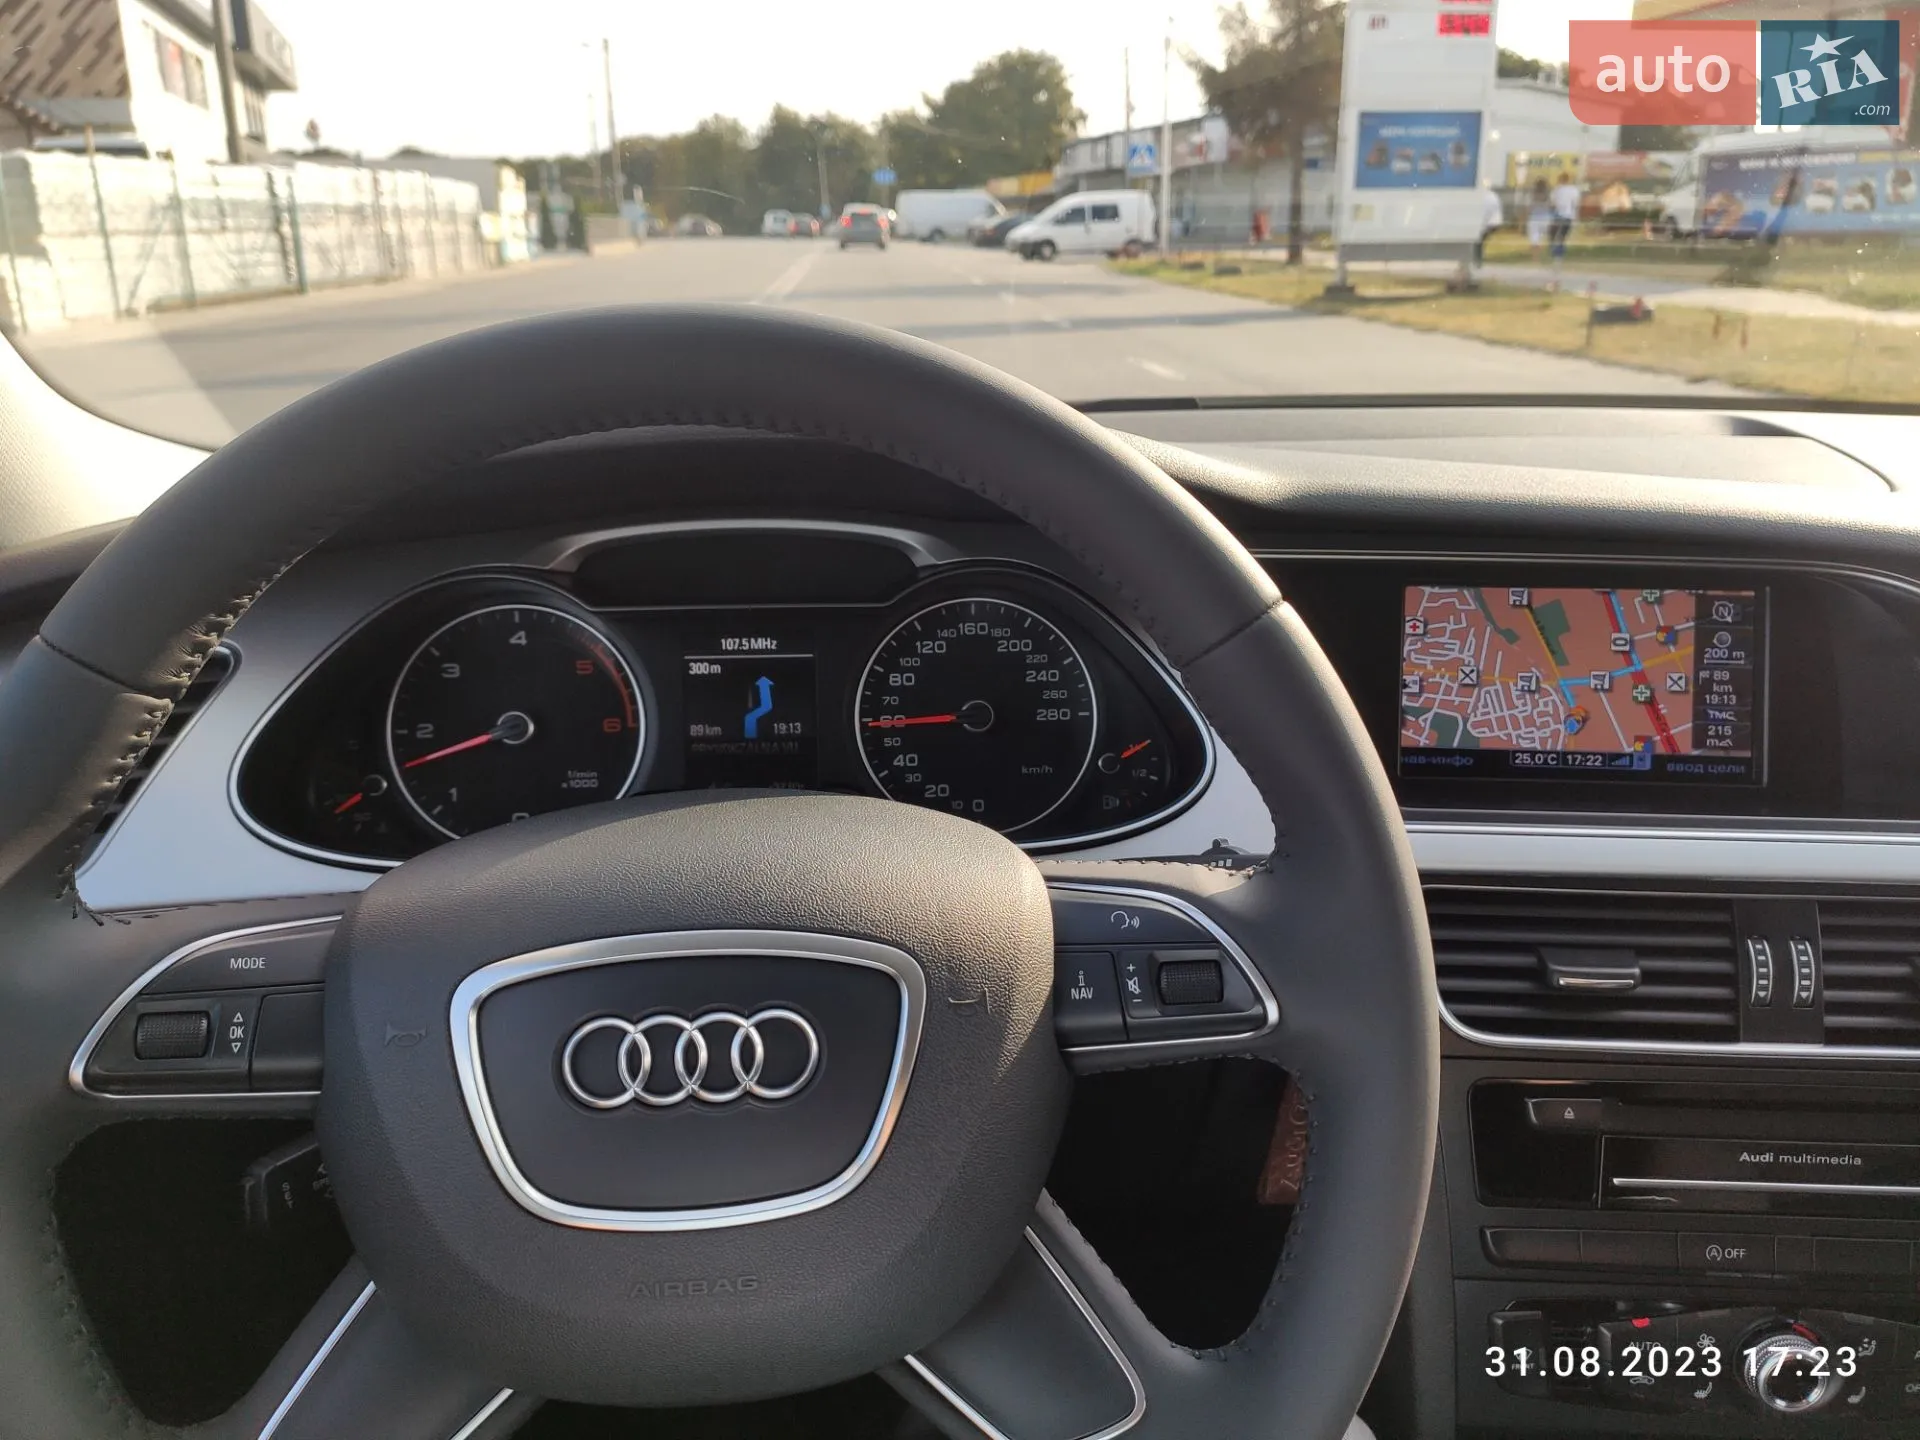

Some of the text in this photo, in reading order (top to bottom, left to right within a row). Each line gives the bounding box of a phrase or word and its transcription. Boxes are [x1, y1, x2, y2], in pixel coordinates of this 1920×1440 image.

[937, 628, 957, 638] 140
[958, 622, 988, 635] 160
[509, 631, 527, 646] 4
[915, 641, 947, 654] 120
[997, 639, 1032, 652] 200
[1026, 654, 1048, 664] 220
[1704, 649, 1745, 660] 200 m
[576, 660, 594, 674] 5
[900, 657, 920, 667] 100
[440, 663, 461, 678] 3
[1025, 670, 1060, 683] 240
[889, 673, 915, 686] 80
[881, 696, 899, 706] 70
[1042, 690, 1068, 700] 260
[1705, 694, 1737, 705] 19:13
[1036, 709, 1071, 721] 280
[416, 724, 434, 738] 2
[602, 718, 621, 732] 6
[773, 723, 801, 735] 19:13
[1707, 725, 1732, 736] 215
[883, 737, 901, 747] 50
[893, 754, 919, 767] 40
[1566, 754, 1602, 767] 17:22
[1021, 764, 1054, 775] km/h
[904, 773, 921, 783] 30
[449, 787, 458, 801] 1
[924, 785, 950, 798] 20
[972, 799, 985, 812] 0
[229, 957, 266, 970] MODE
[1070, 987, 1093, 1000] NAV
[229, 1026, 244, 1040] OK
[1739, 1151, 1862, 1166] Audi multimedia
[1725, 1247, 1746, 1260] OFF
[630, 1275, 758, 1299] AIRBAG
